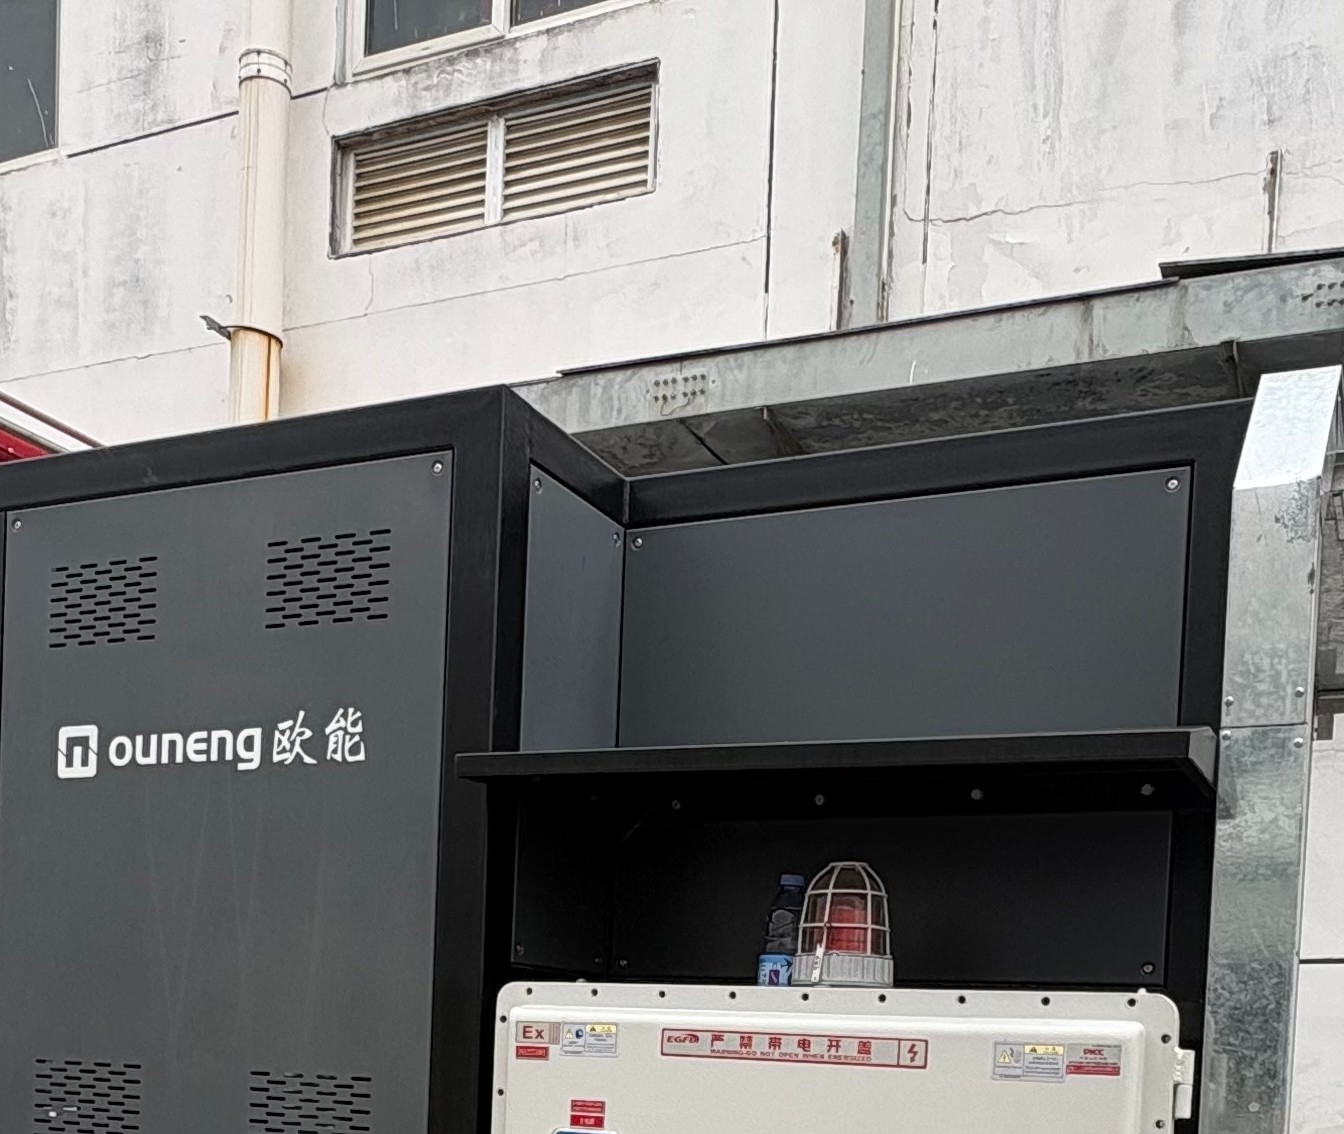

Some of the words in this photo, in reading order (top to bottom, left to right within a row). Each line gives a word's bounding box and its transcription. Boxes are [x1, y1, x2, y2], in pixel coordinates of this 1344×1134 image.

[109, 727, 262, 771] ouneng
[272, 707, 366, 765] 欧能
[522, 1025, 545, 1040] Ex
